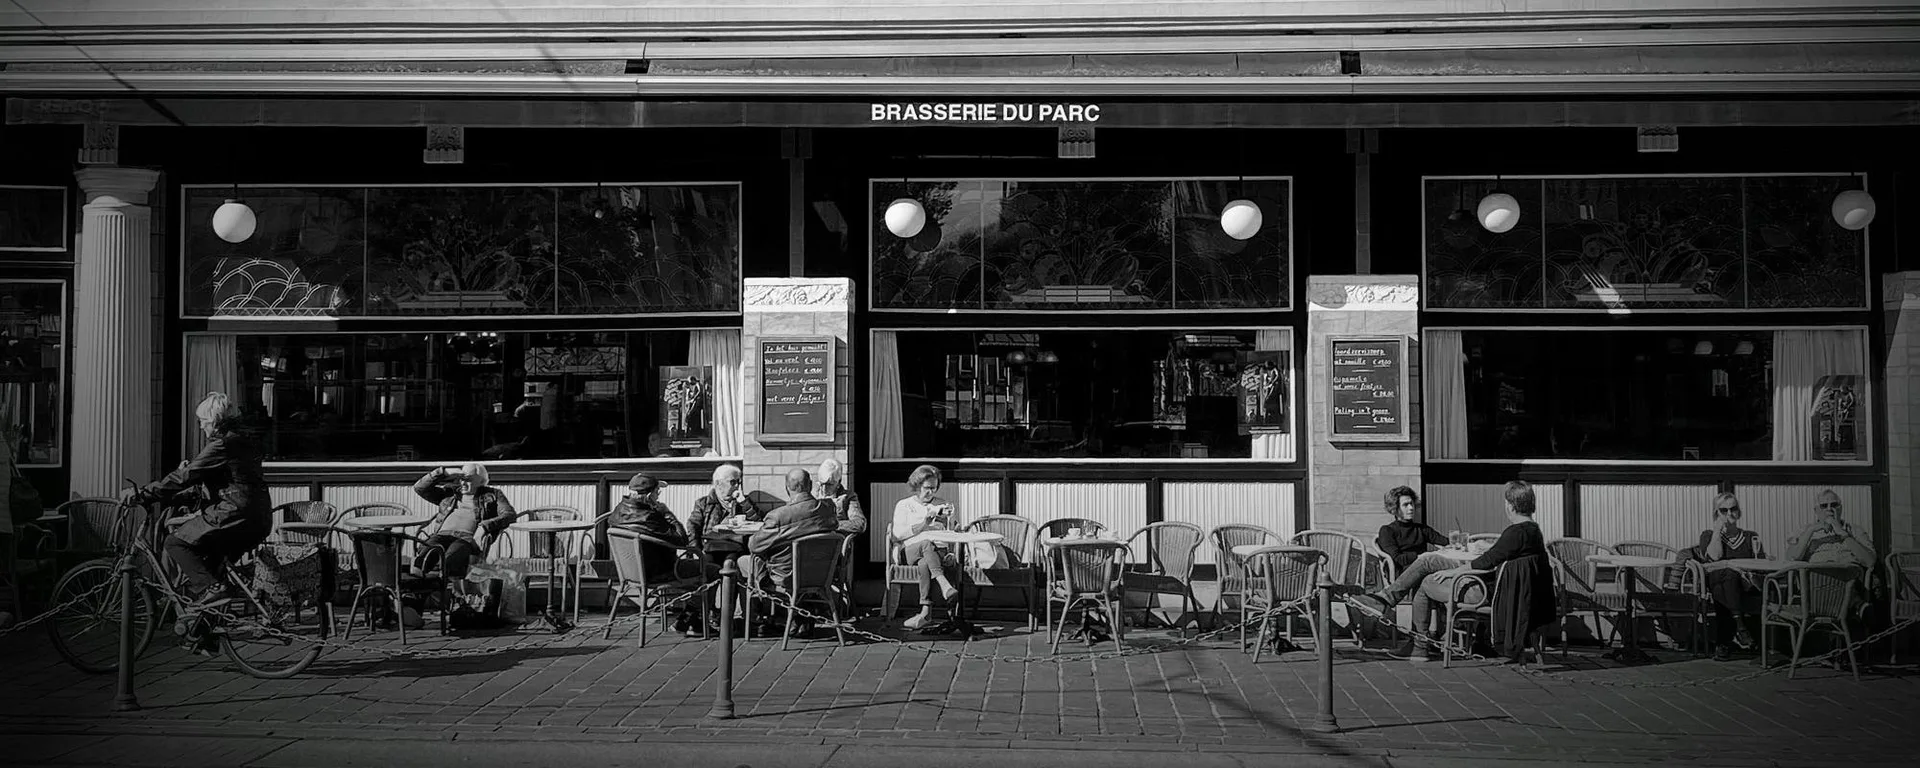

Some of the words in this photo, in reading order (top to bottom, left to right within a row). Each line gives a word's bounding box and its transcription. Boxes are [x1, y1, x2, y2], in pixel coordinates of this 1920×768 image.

[871, 103, 997, 121] BRASSERIE
[1003, 104, 1033, 121] DU
[1039, 104, 1100, 121] PARC
